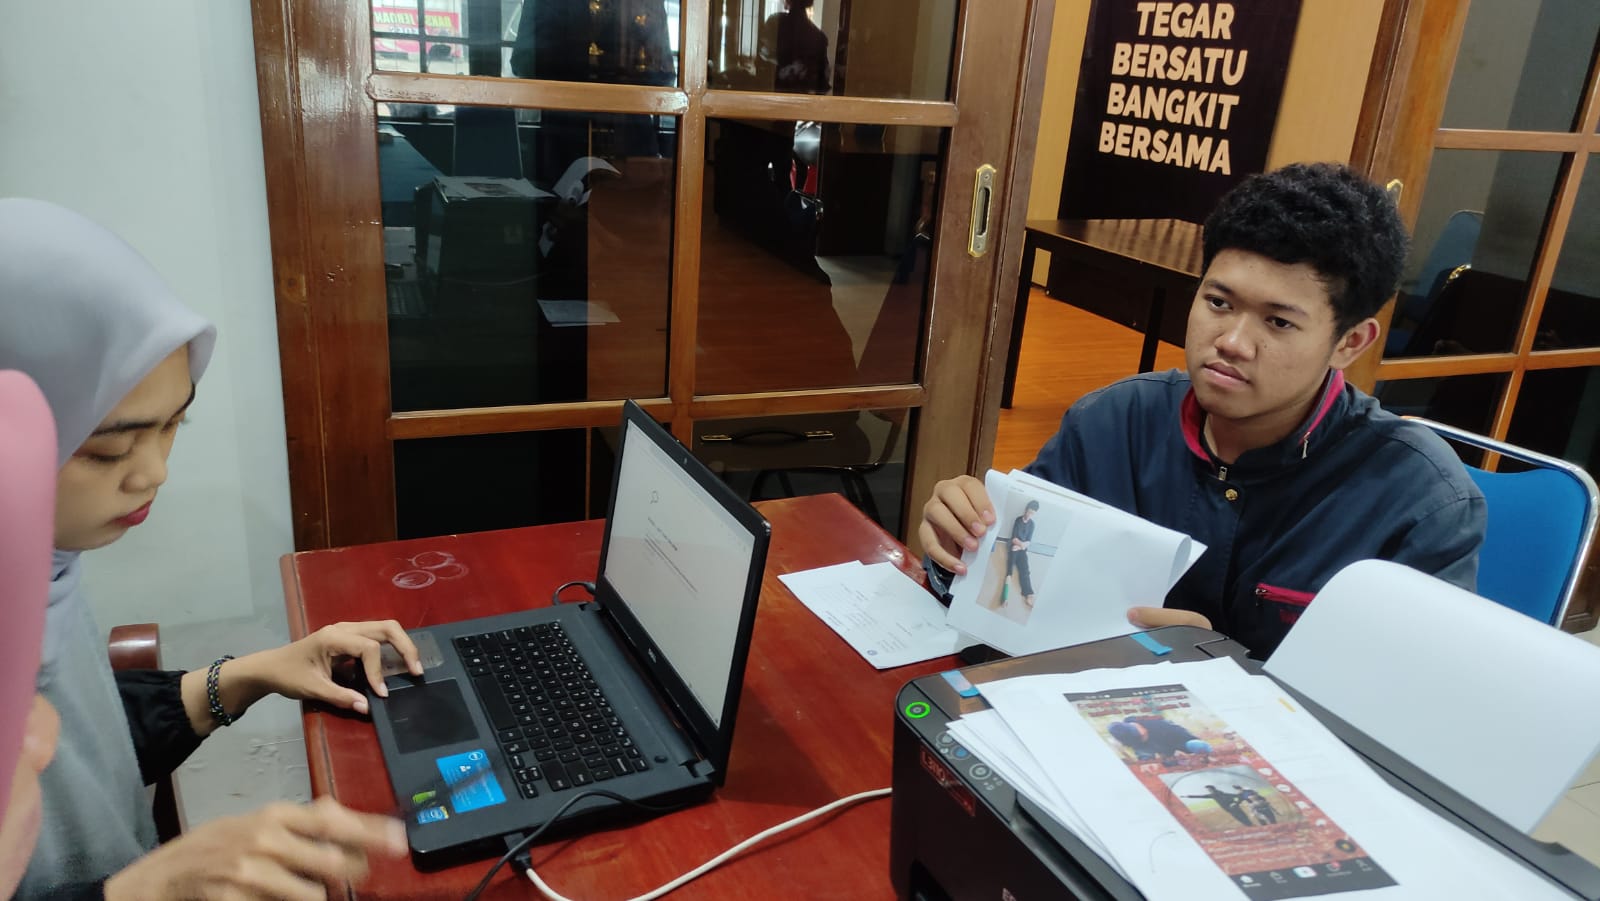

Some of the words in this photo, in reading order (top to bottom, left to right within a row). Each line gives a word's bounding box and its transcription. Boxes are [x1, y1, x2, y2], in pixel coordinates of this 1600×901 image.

[1136, 2, 1235, 40] TEGAR
[1111, 42, 1248, 86] BERSATU
[1106, 82, 1240, 130] BANGKIT
[1098, 121, 1231, 175] BERSAMA
